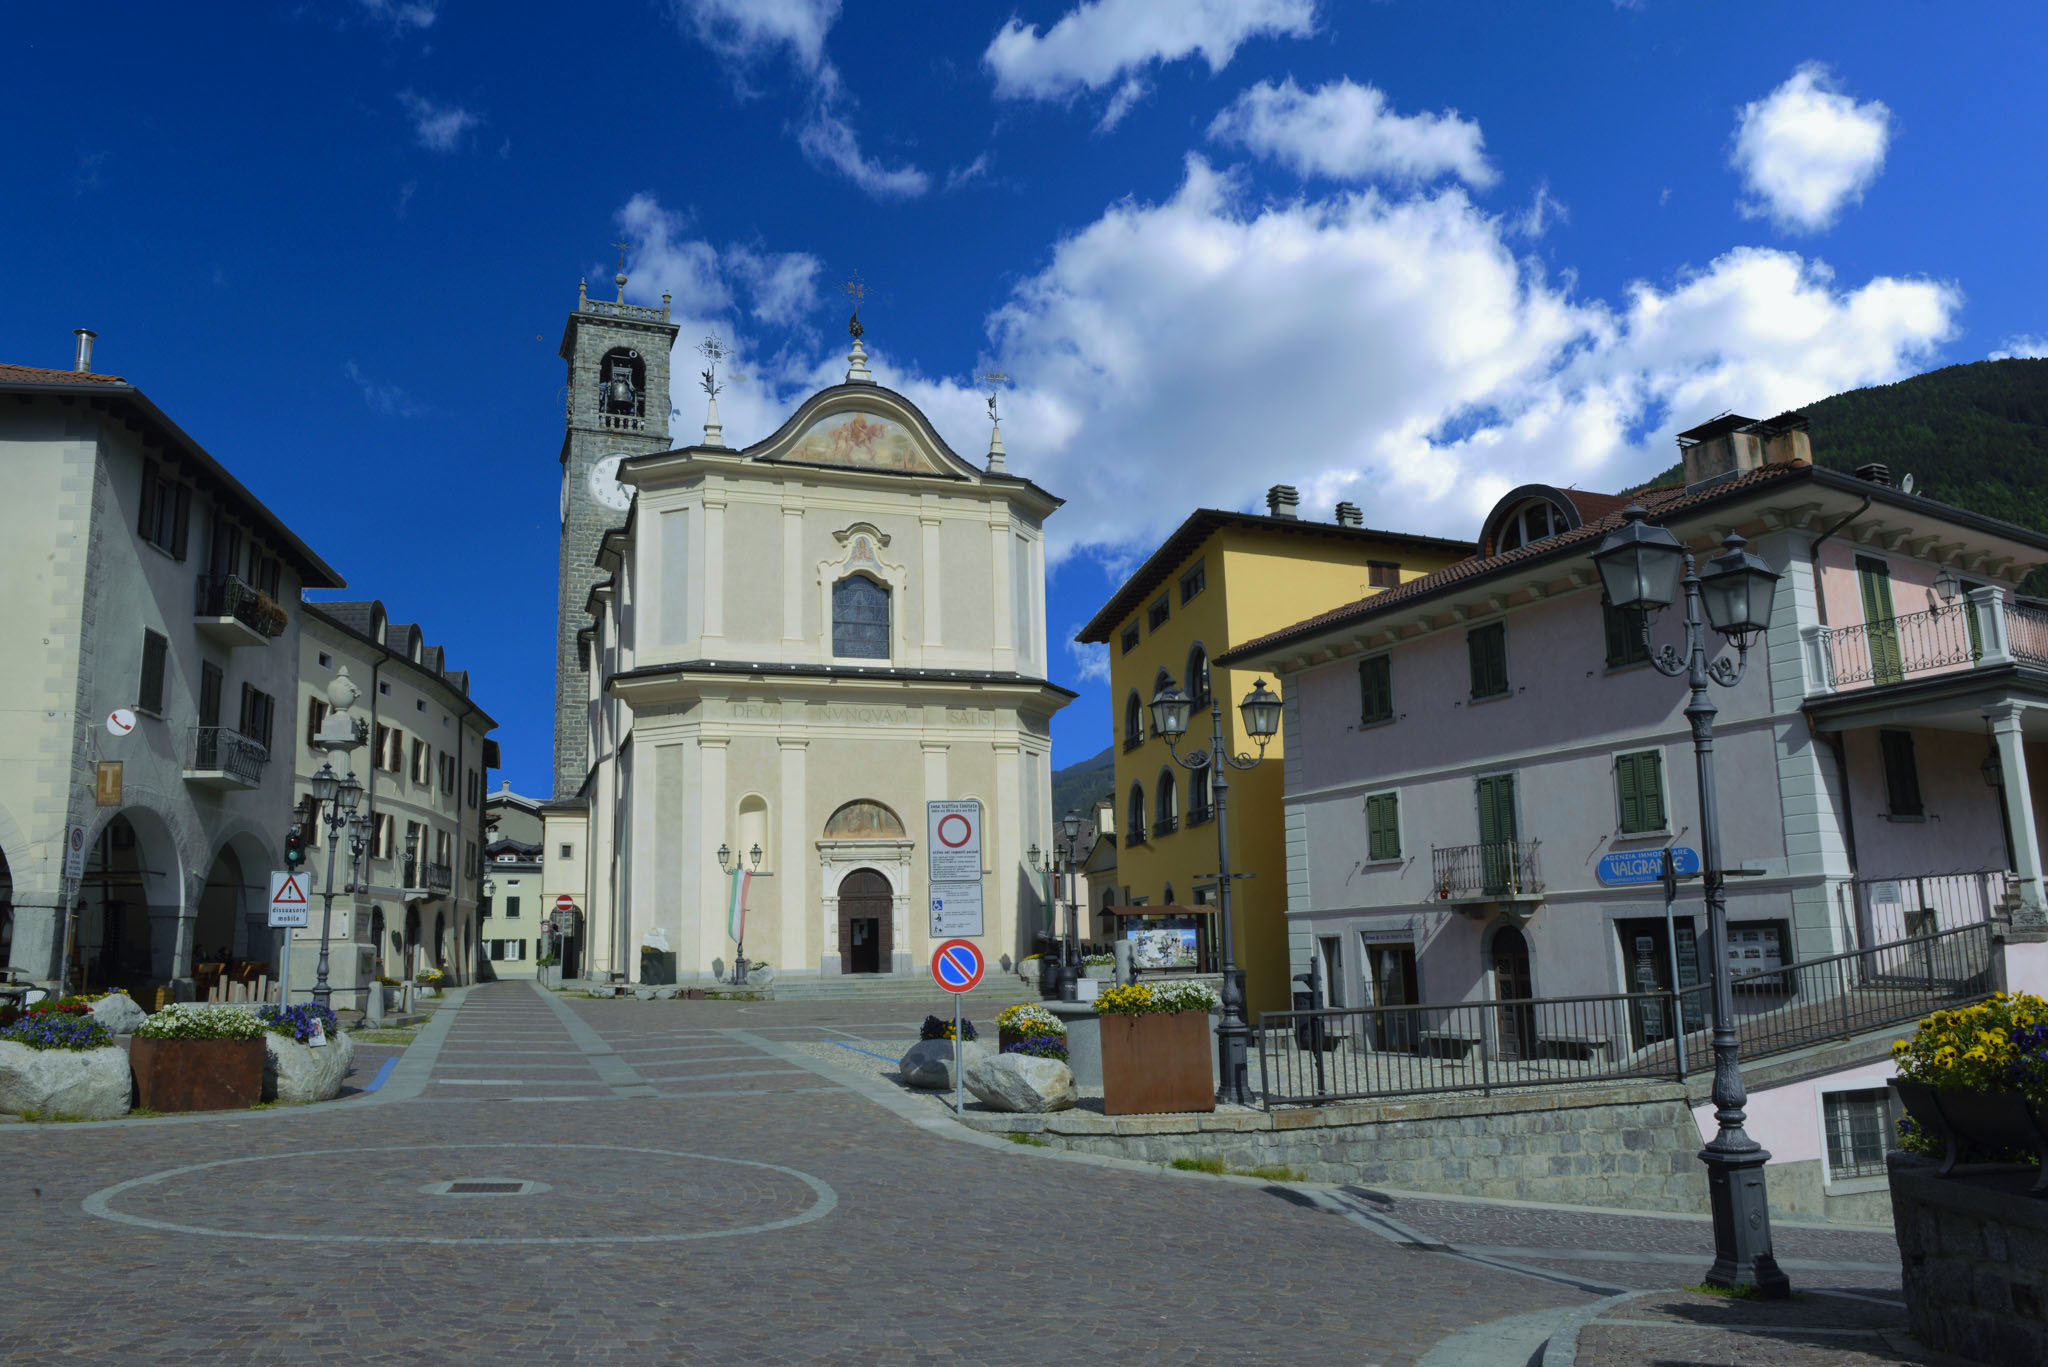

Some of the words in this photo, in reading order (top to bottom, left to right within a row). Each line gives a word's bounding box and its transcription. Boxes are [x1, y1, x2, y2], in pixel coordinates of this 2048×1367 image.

[817, 708, 910, 724] NVNQVAM
[950, 711, 992, 725] SATIS
[1604, 853, 1637, 861] AGENZIA
[1638, 848, 1689, 858] IMMOBARE
[1610, 856, 1685, 876] VALGRANE
